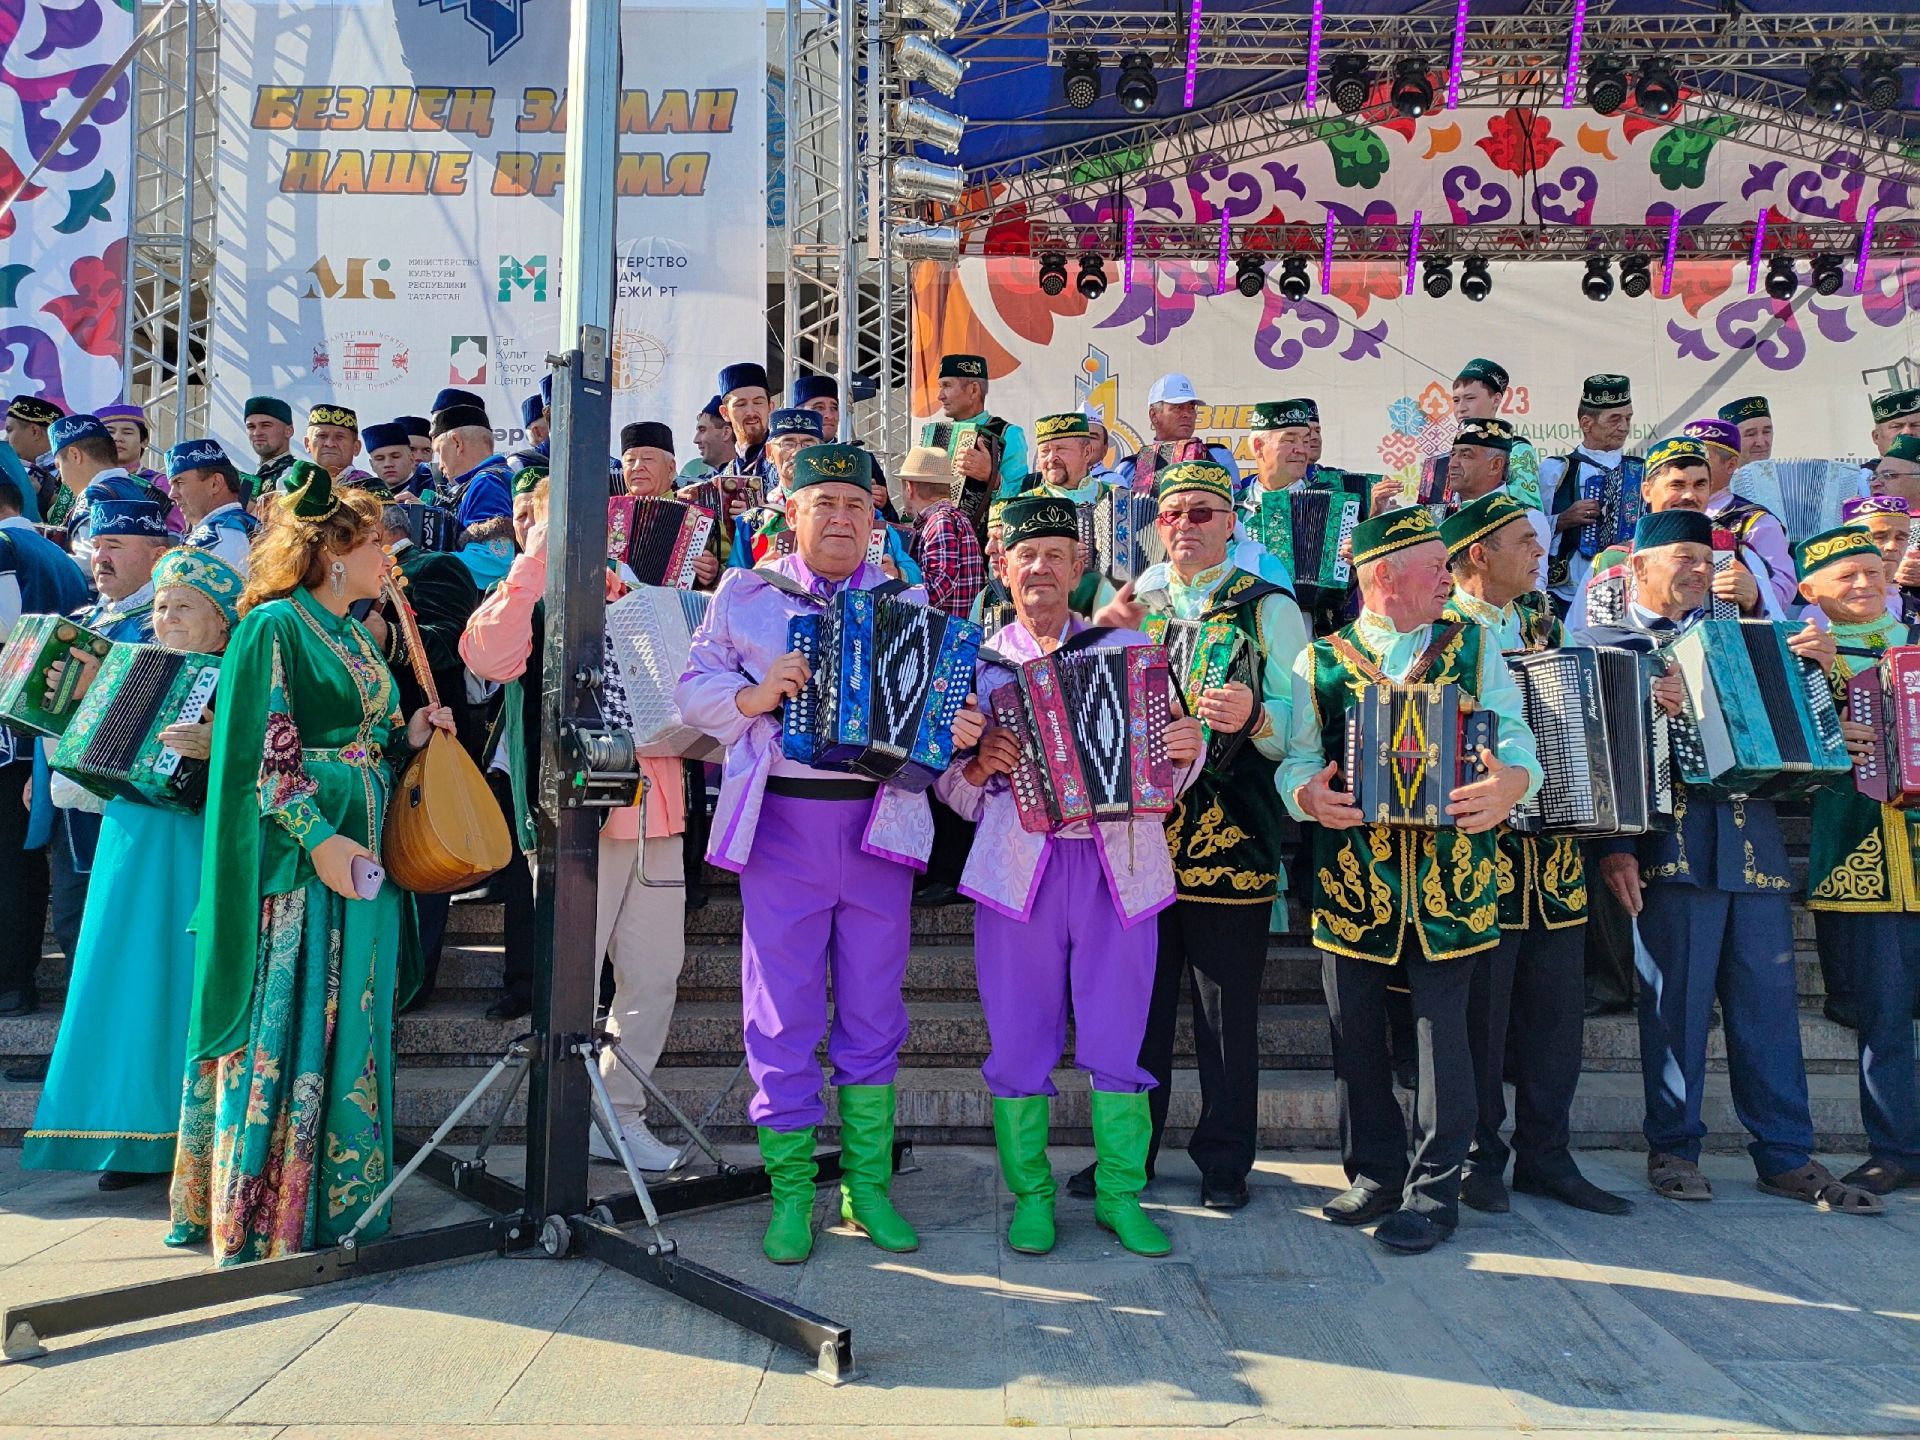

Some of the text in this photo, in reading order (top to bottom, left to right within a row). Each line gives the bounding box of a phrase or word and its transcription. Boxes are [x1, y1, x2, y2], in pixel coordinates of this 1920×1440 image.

[279, 149, 711, 197] НАШЕ ВРМЯ
[408, 258, 480, 267] МИНИСТЕРСТВО
[408, 270, 456, 278] КУЛЬТУРЫ
[408, 281, 467, 290] РЕСПУБЛИКИ
[407, 293, 461, 301] ТАТАРСТАН
[660, 286, 678, 297] РТ
[496, 335, 515, 346] Тат
[496, 348, 528, 360] Культ
[495, 361, 537, 374] Ресурс
[494, 377, 532, 388] Центр
[1047, 710, 1068, 762] Шуйская
